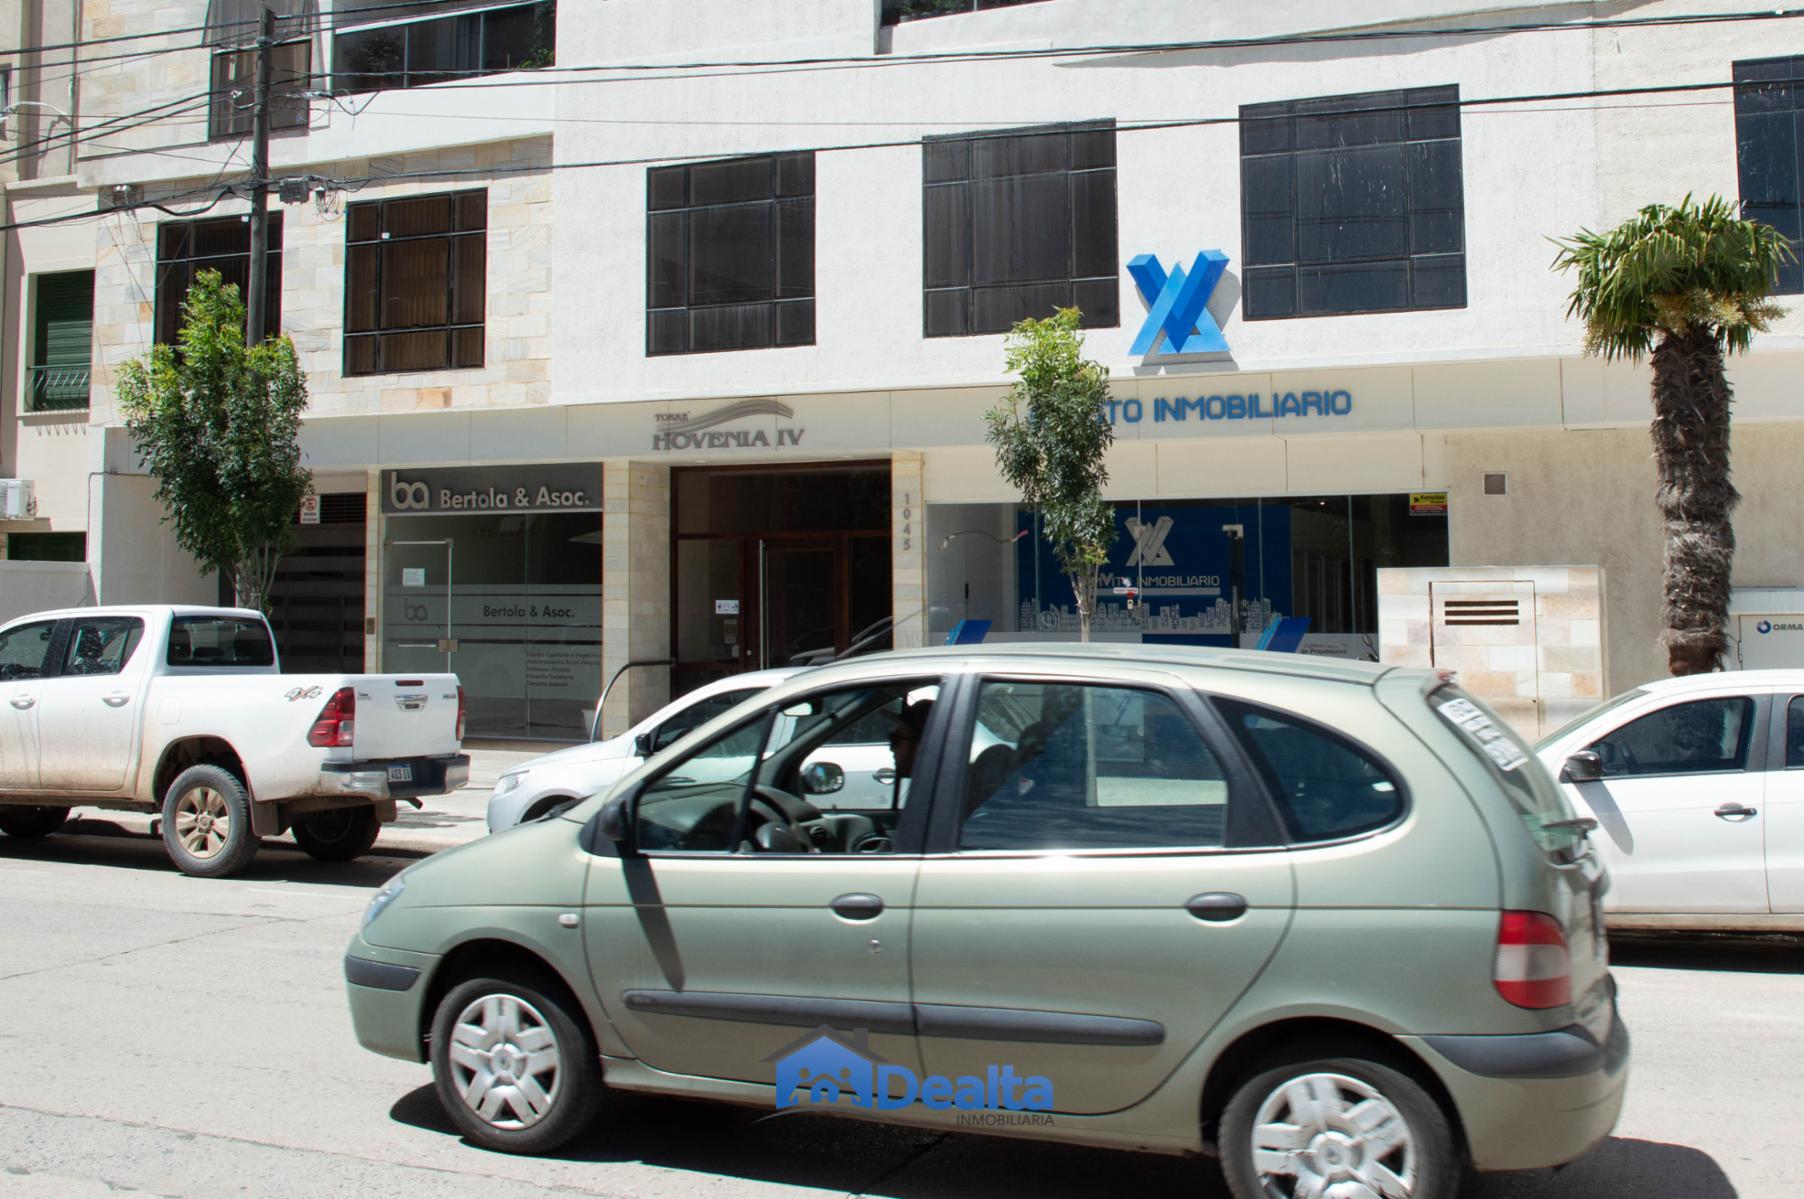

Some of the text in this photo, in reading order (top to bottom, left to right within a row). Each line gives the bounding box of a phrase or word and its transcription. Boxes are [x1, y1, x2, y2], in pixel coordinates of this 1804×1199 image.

[1153, 389, 1352, 423] INMOBILIARIO
[652, 428, 805, 451] HOVENIA IV
[440, 486, 590, 509] Bertola & Asoc.
[1136, 575, 1220, 587] INMOBILIARIO
[483, 604, 576, 618] Bertola & Asoc.
